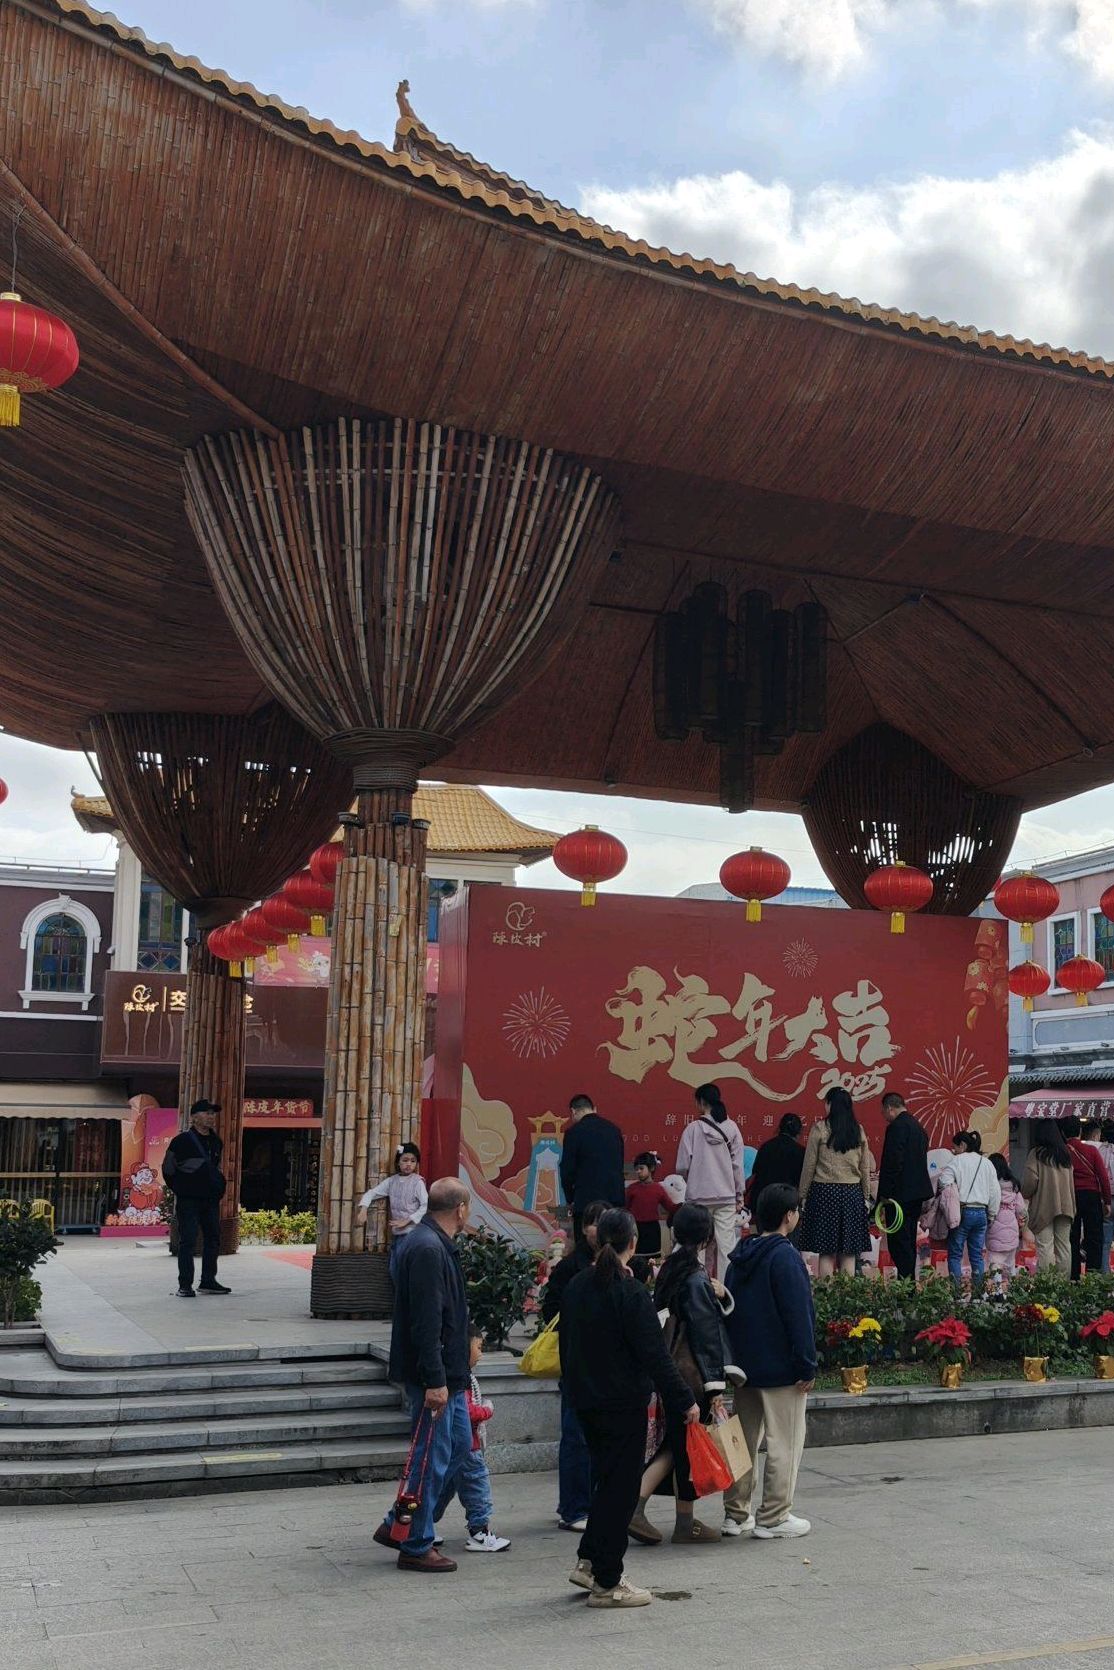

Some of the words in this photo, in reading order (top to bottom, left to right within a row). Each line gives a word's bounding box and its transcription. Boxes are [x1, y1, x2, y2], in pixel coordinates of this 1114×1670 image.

[596, 965, 903, 1101] 蛇年大吉
[816, 1064, 893, 1101] 2025
